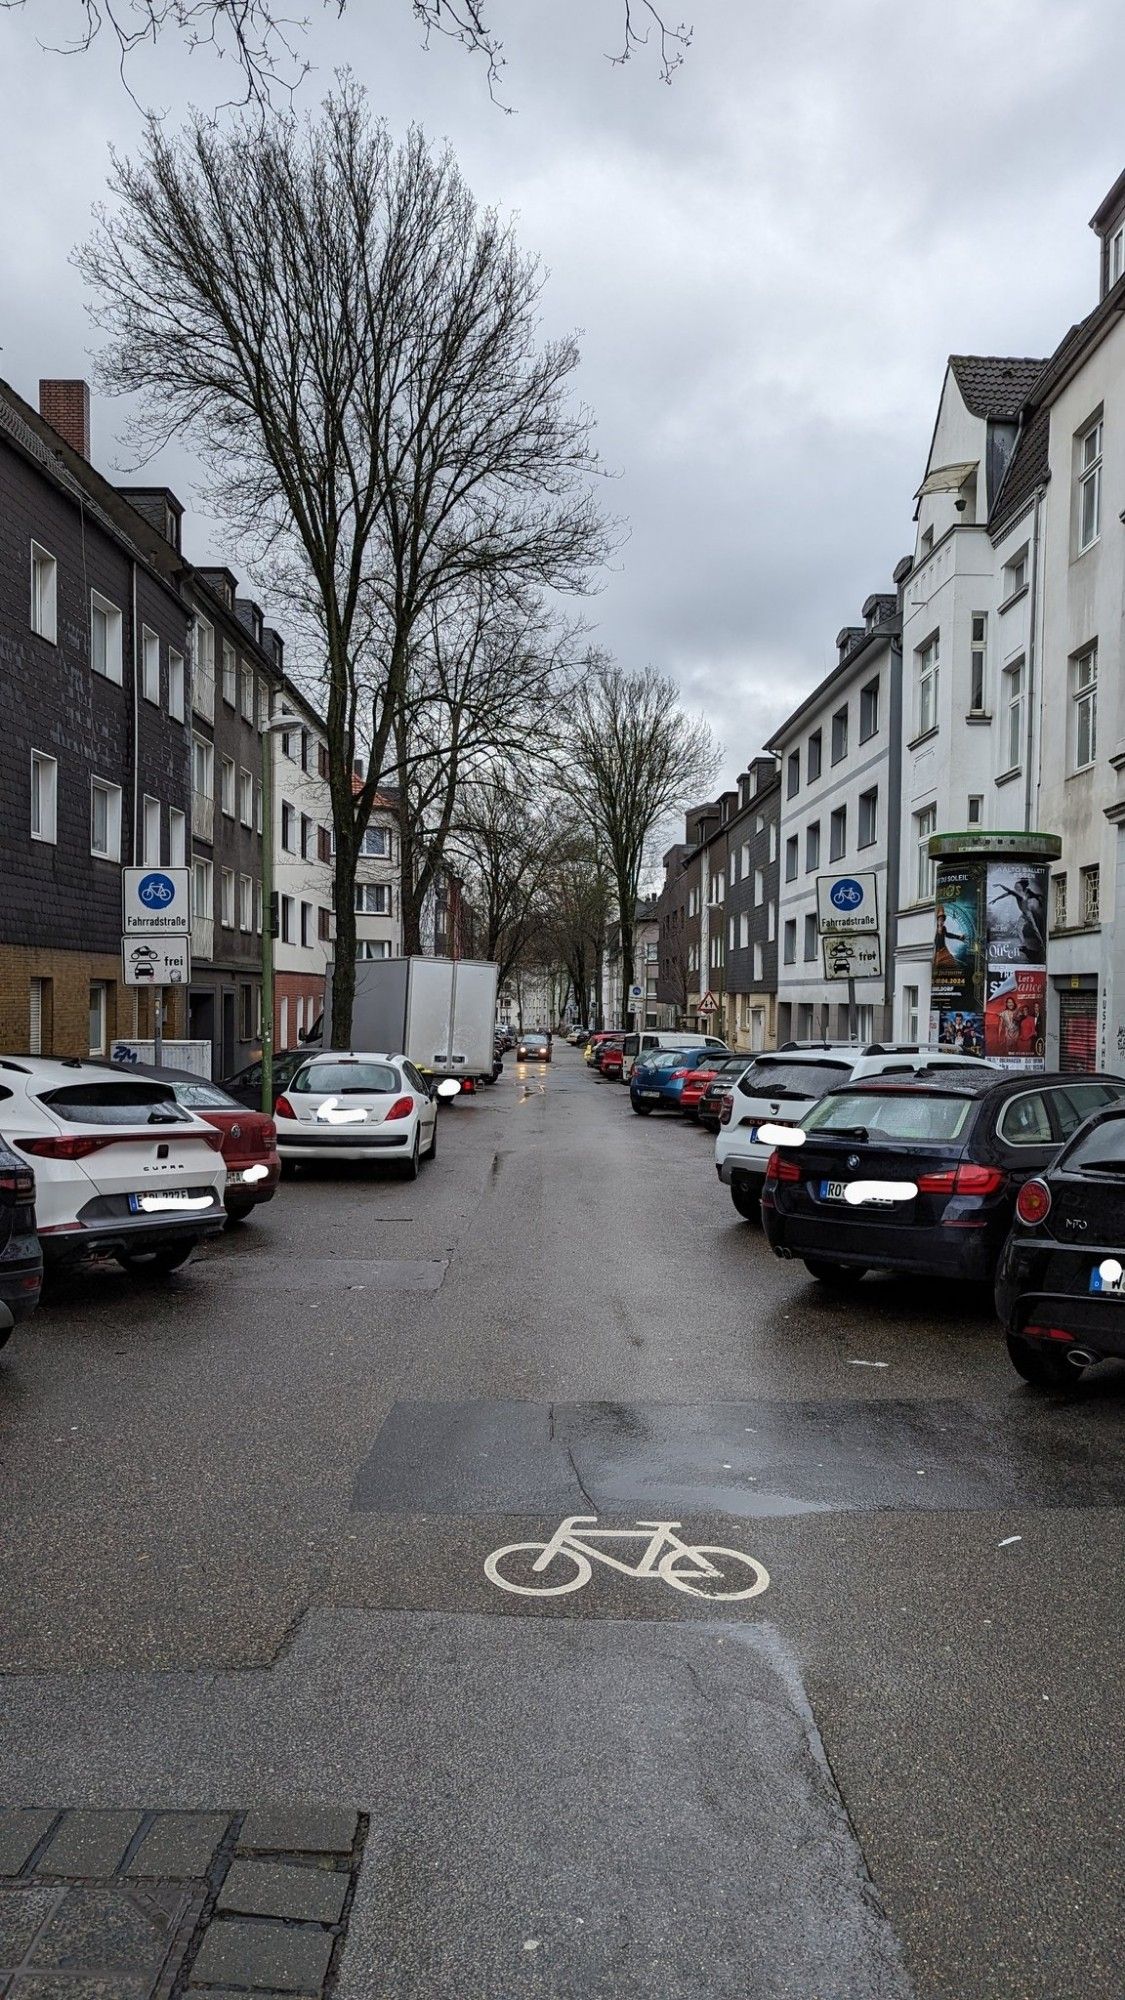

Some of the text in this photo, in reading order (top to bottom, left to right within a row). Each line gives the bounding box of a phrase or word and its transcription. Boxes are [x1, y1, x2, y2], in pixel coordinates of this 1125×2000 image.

[127, 916, 187, 927] Fahrradstraße
[821, 916, 875, 928] Fahrradstraße
[164, 956, 184, 966] frei
[858, 951, 877, 961] frei
[143, 1164, 185, 1172] CUPRA
